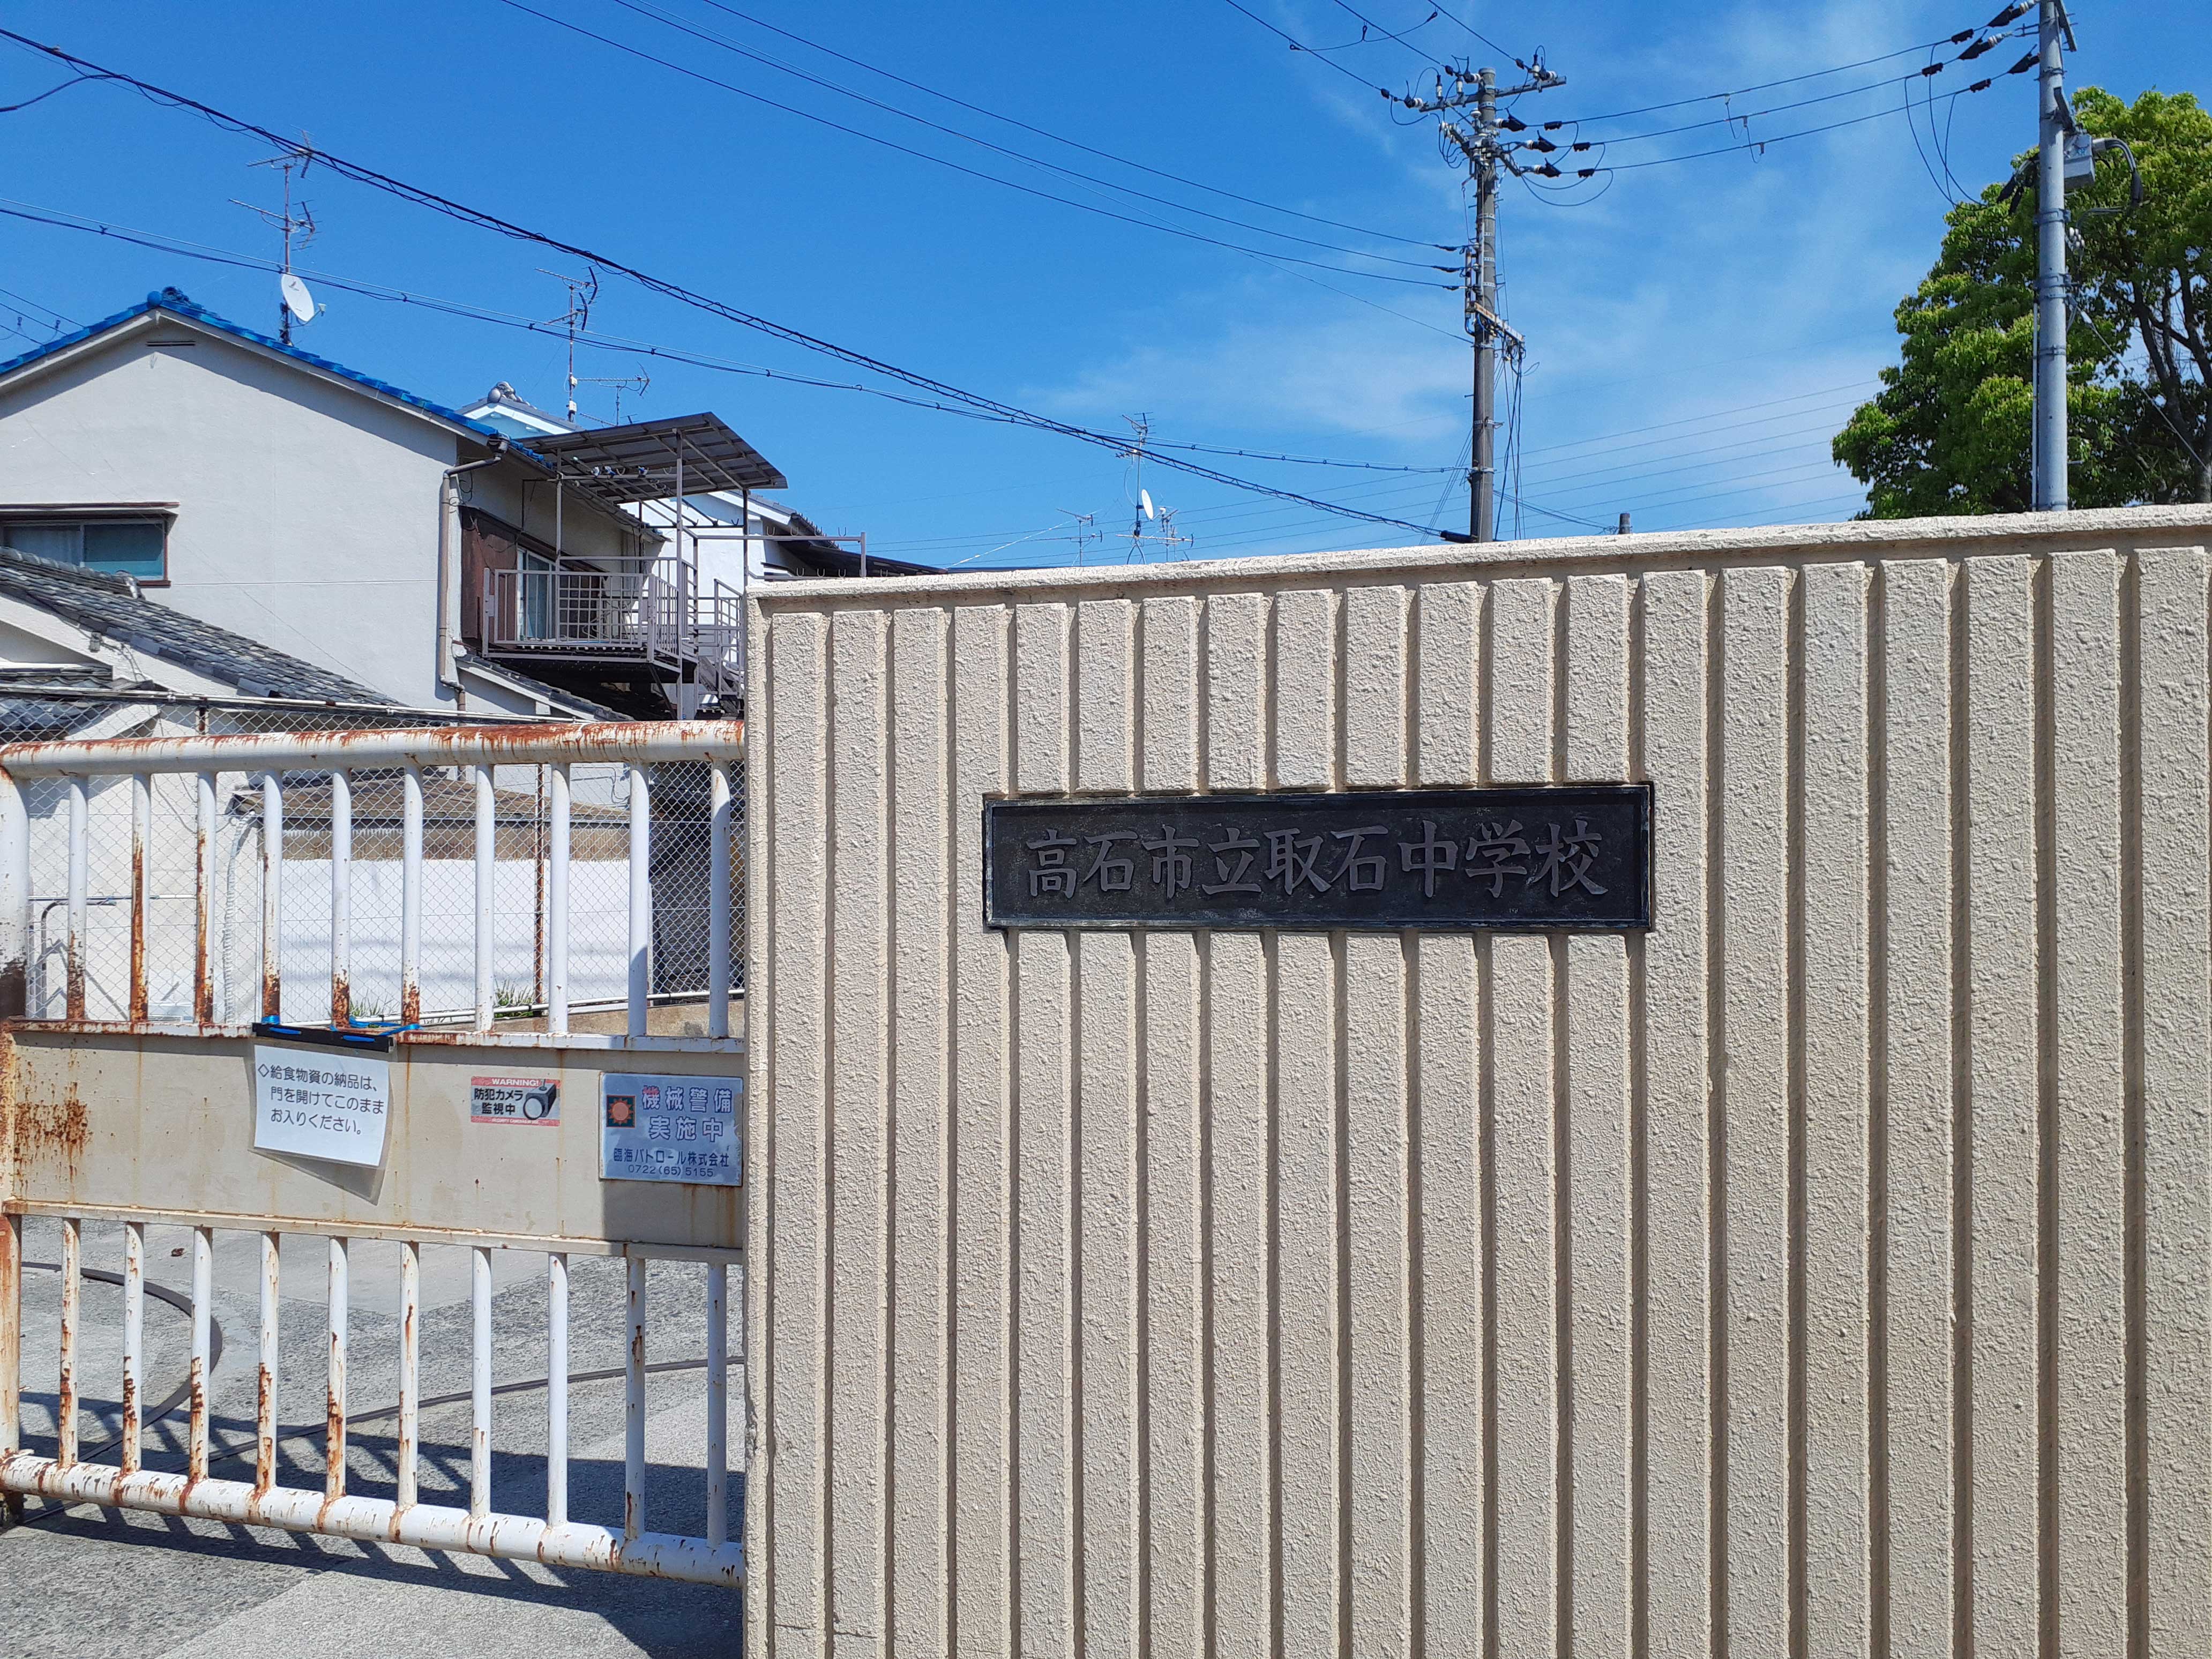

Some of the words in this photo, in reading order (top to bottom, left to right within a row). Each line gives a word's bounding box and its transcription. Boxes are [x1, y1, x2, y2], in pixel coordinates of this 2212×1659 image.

[1026, 820, 1609, 899] 高石市立取石中学校
[474, 1088, 524, 1101] 防犯カメラ
[492, 1078, 539, 1086] WARNING!
[271, 1086, 384, 1114] 門を開けてこのまま
[482, 1103, 515, 1115] 監視中
[642, 1085, 733, 1113] 機械警備
[271, 1109, 362, 1135] お入りください。
[649, 1115, 723, 1142] 実施中
